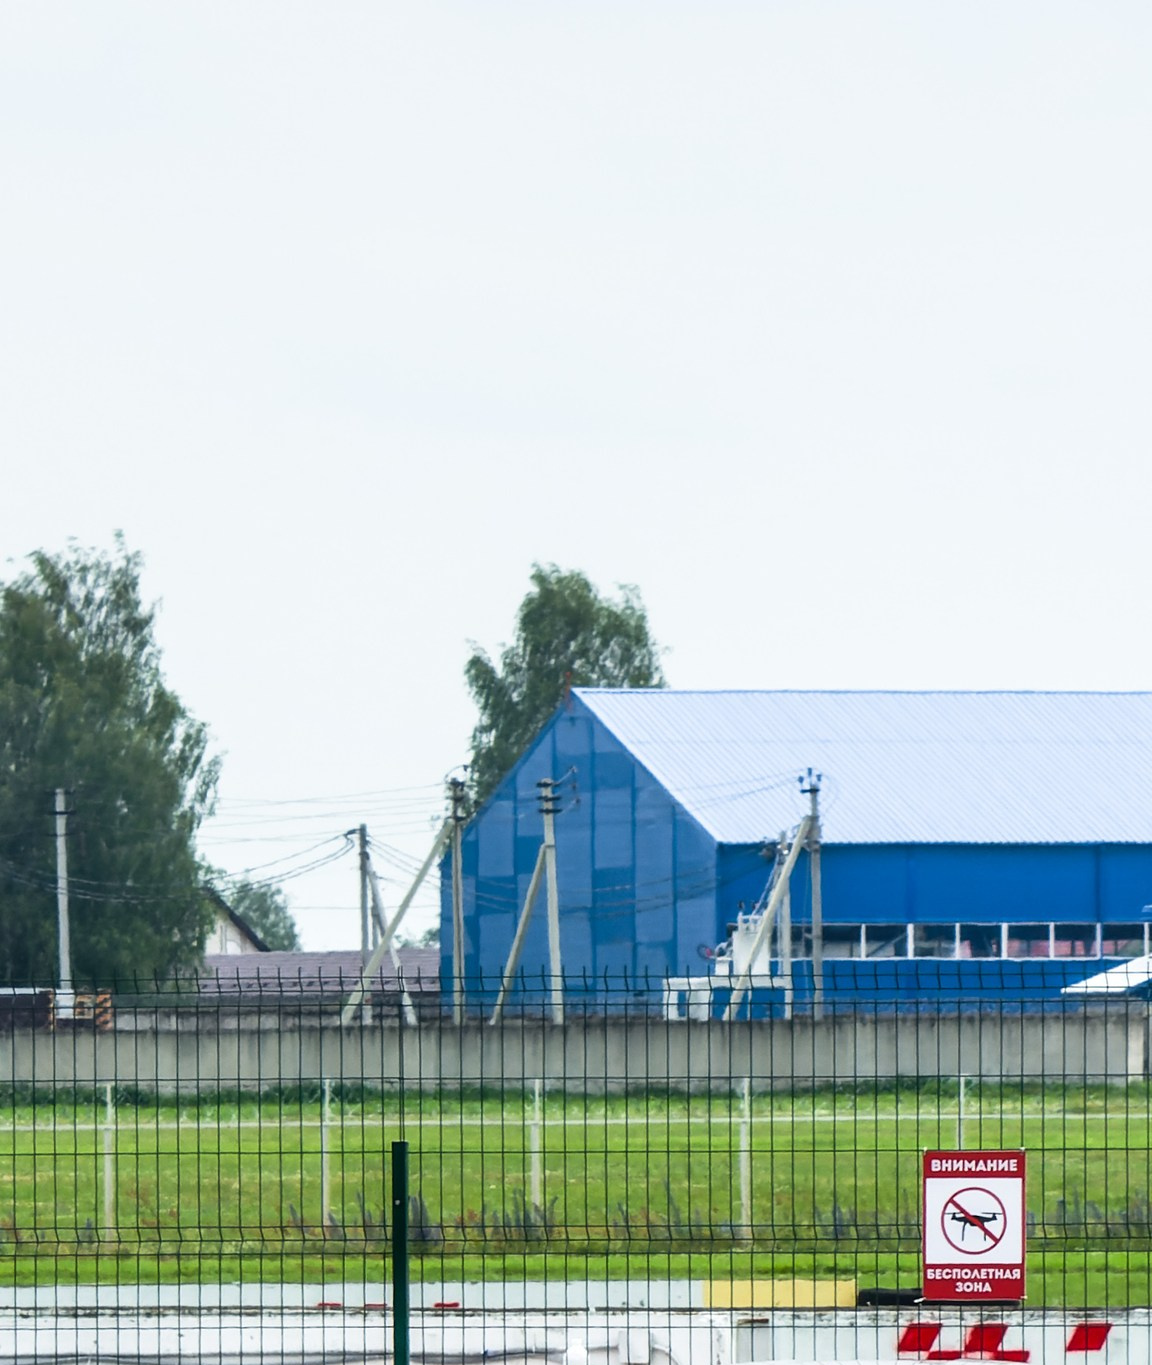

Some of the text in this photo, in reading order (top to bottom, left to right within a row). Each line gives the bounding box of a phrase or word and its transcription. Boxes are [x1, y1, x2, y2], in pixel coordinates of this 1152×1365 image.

[931, 1159, 1018, 1172] ВНИМАНИЕ
[927, 1268, 1021, 1280] БЕСПОЛЕТНАЯ
[955, 1282, 992, 1292] ЗОНА
